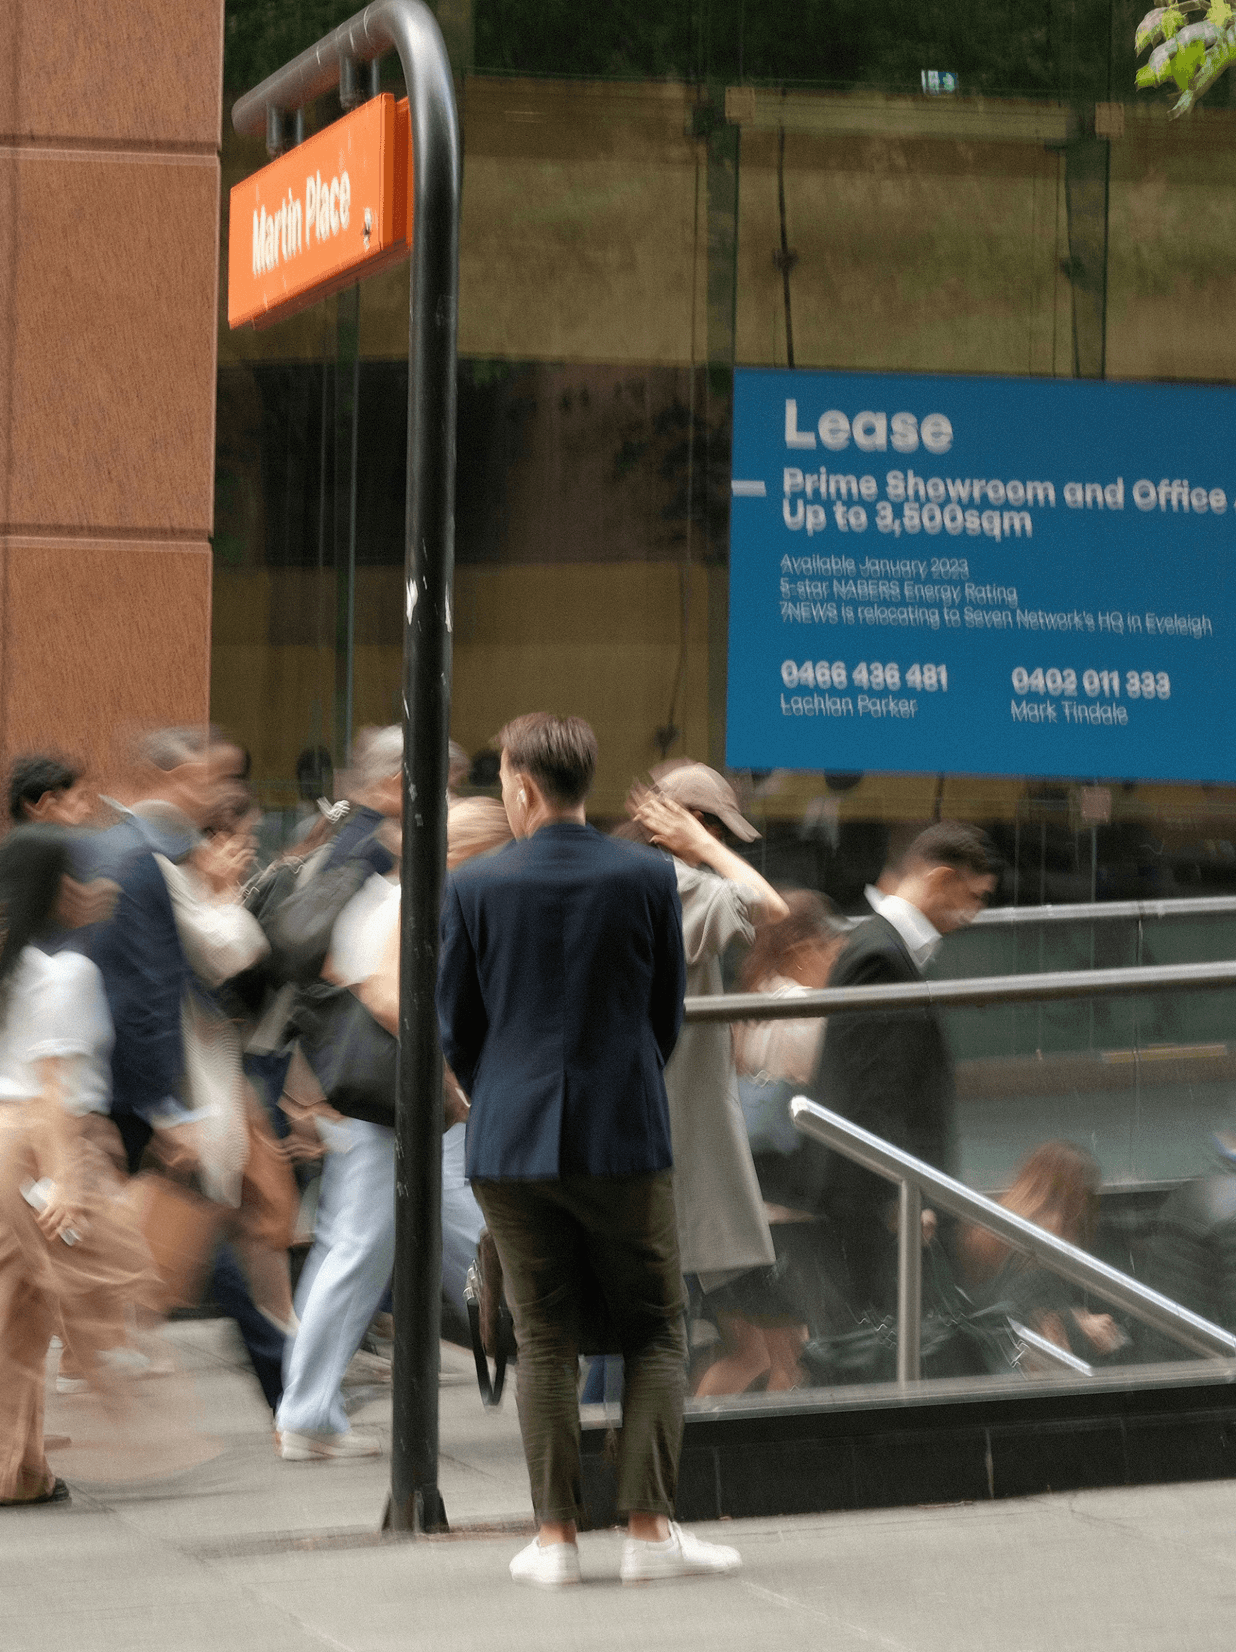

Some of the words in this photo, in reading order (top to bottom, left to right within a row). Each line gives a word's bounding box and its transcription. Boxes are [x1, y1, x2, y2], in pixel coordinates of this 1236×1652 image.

[252, 187, 302, 279] Martin
[305, 169, 351, 250] Place
[785, 398, 954, 455] Lease
[783, 465, 879, 502] Prime
[885, 469, 1056, 508] Showroom
[1064, 476, 1125, 511] and
[1132, 478, 1228, 515] Office
[782, 498, 827, 537] Up
[832, 501, 868, 533] to
[875, 500, 1032, 543] 3,500sqm
[780, 554, 857, 577] Available
[859, 556, 929, 581] January
[930, 557, 970, 580] 2023
[779, 577, 830, 600] 5-star
[832, 578, 901, 602] NABERS
[903, 580, 962, 606] Energy
[964, 582, 1018, 609] Rating
[779, 600, 839, 625] 7NEWS
[841, 602, 856, 625] is
[857, 603, 941, 630] relocating
[943, 605, 962, 628] to
[963, 605, 1013, 630] Seven
[1016, 608, 1096, 632] Network's
[1097, 611, 1125, 636] HQ
[1126, 612, 1143, 634] in
[1145, 612, 1213, 640] Eveleigh
[780, 659, 848, 690] 0466
[851, 661, 902, 692] 436
[904, 662, 948, 693] 481
[1011, 666, 1078, 697] 0402
[1082, 668, 1121, 699] 011
[1125, 670, 1171, 700] 333
[780, 692, 854, 717] Lachlan
[857, 693, 918, 719] Parker
[1010, 698, 1058, 724] Mark
[1060, 701, 1129, 726] Tindale
